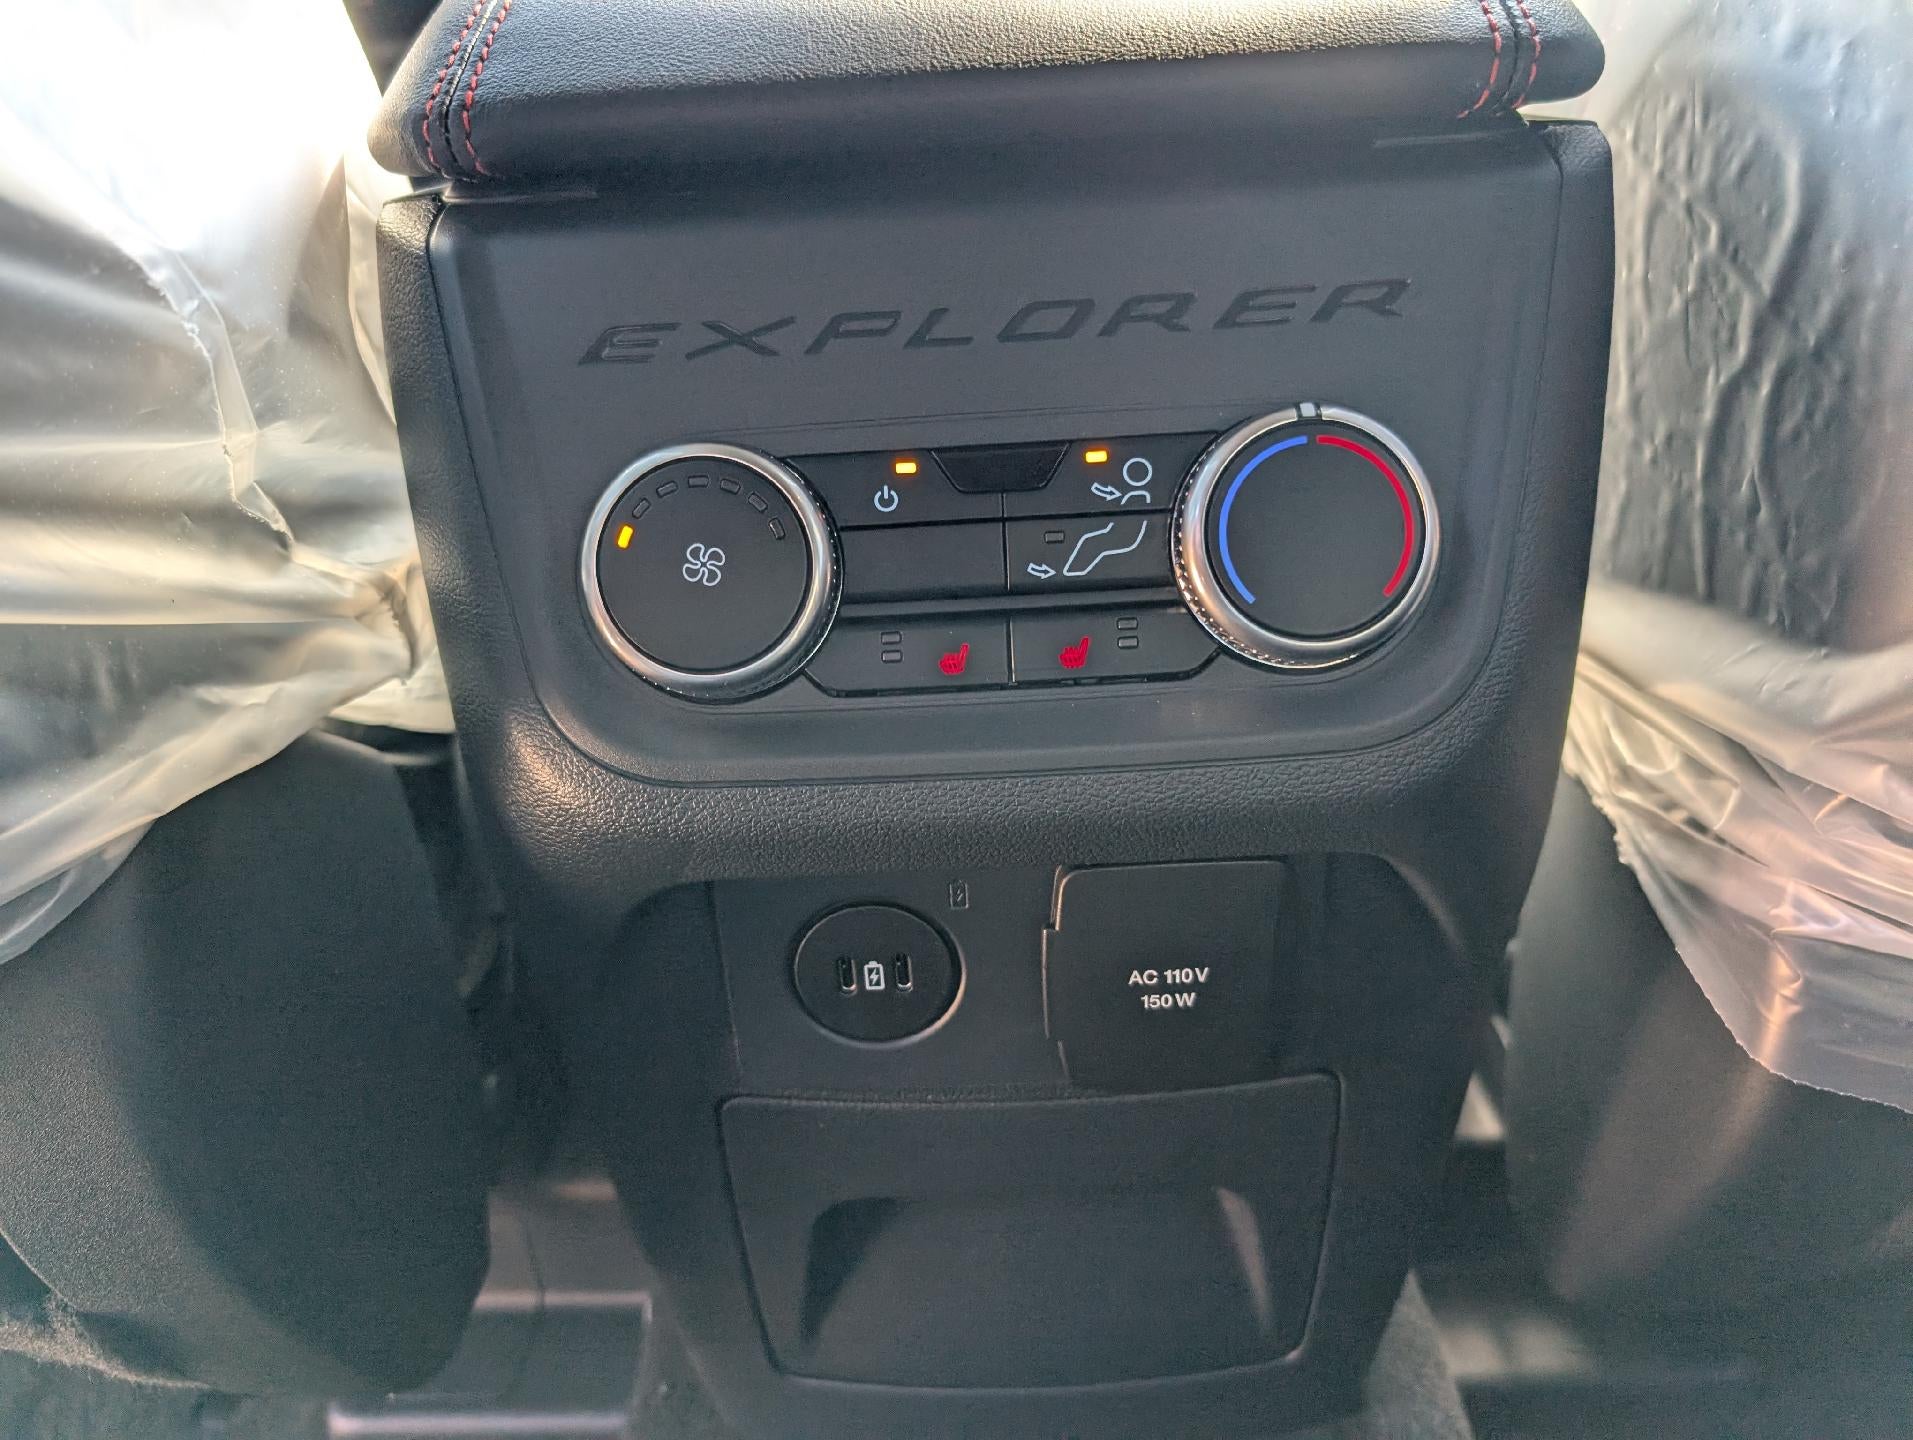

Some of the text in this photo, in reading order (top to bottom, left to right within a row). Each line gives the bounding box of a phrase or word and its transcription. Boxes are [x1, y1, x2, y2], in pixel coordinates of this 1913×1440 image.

[578, 278, 1412, 366] EXPLORER
[1128, 967, 1210, 985] AC 110V
